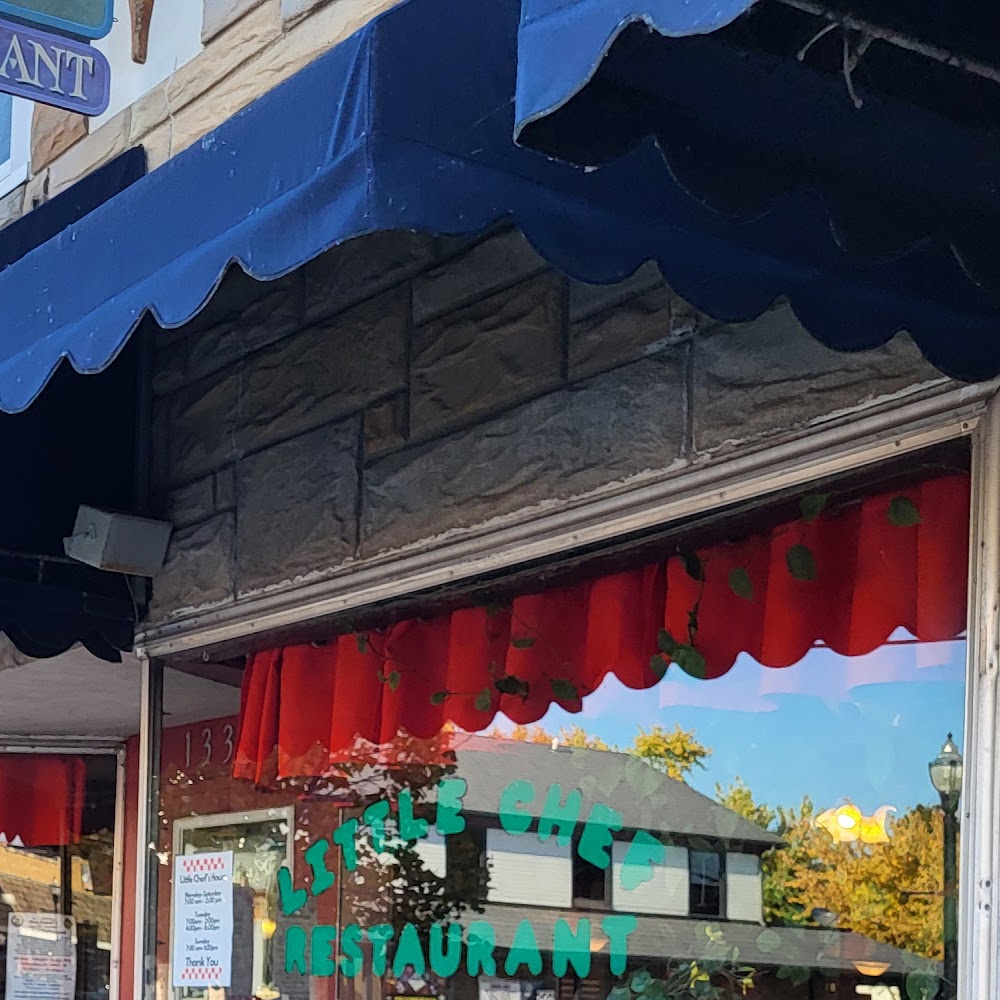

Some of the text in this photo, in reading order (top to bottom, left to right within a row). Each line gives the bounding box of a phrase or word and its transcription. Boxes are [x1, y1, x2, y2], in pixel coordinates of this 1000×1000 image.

[184, 723, 234, 768] 133
[277, 778, 667, 915] LITTLE CHEF
[185, 956, 219, 967] Thank You
[284, 914, 639, 979] RESTAURANT
